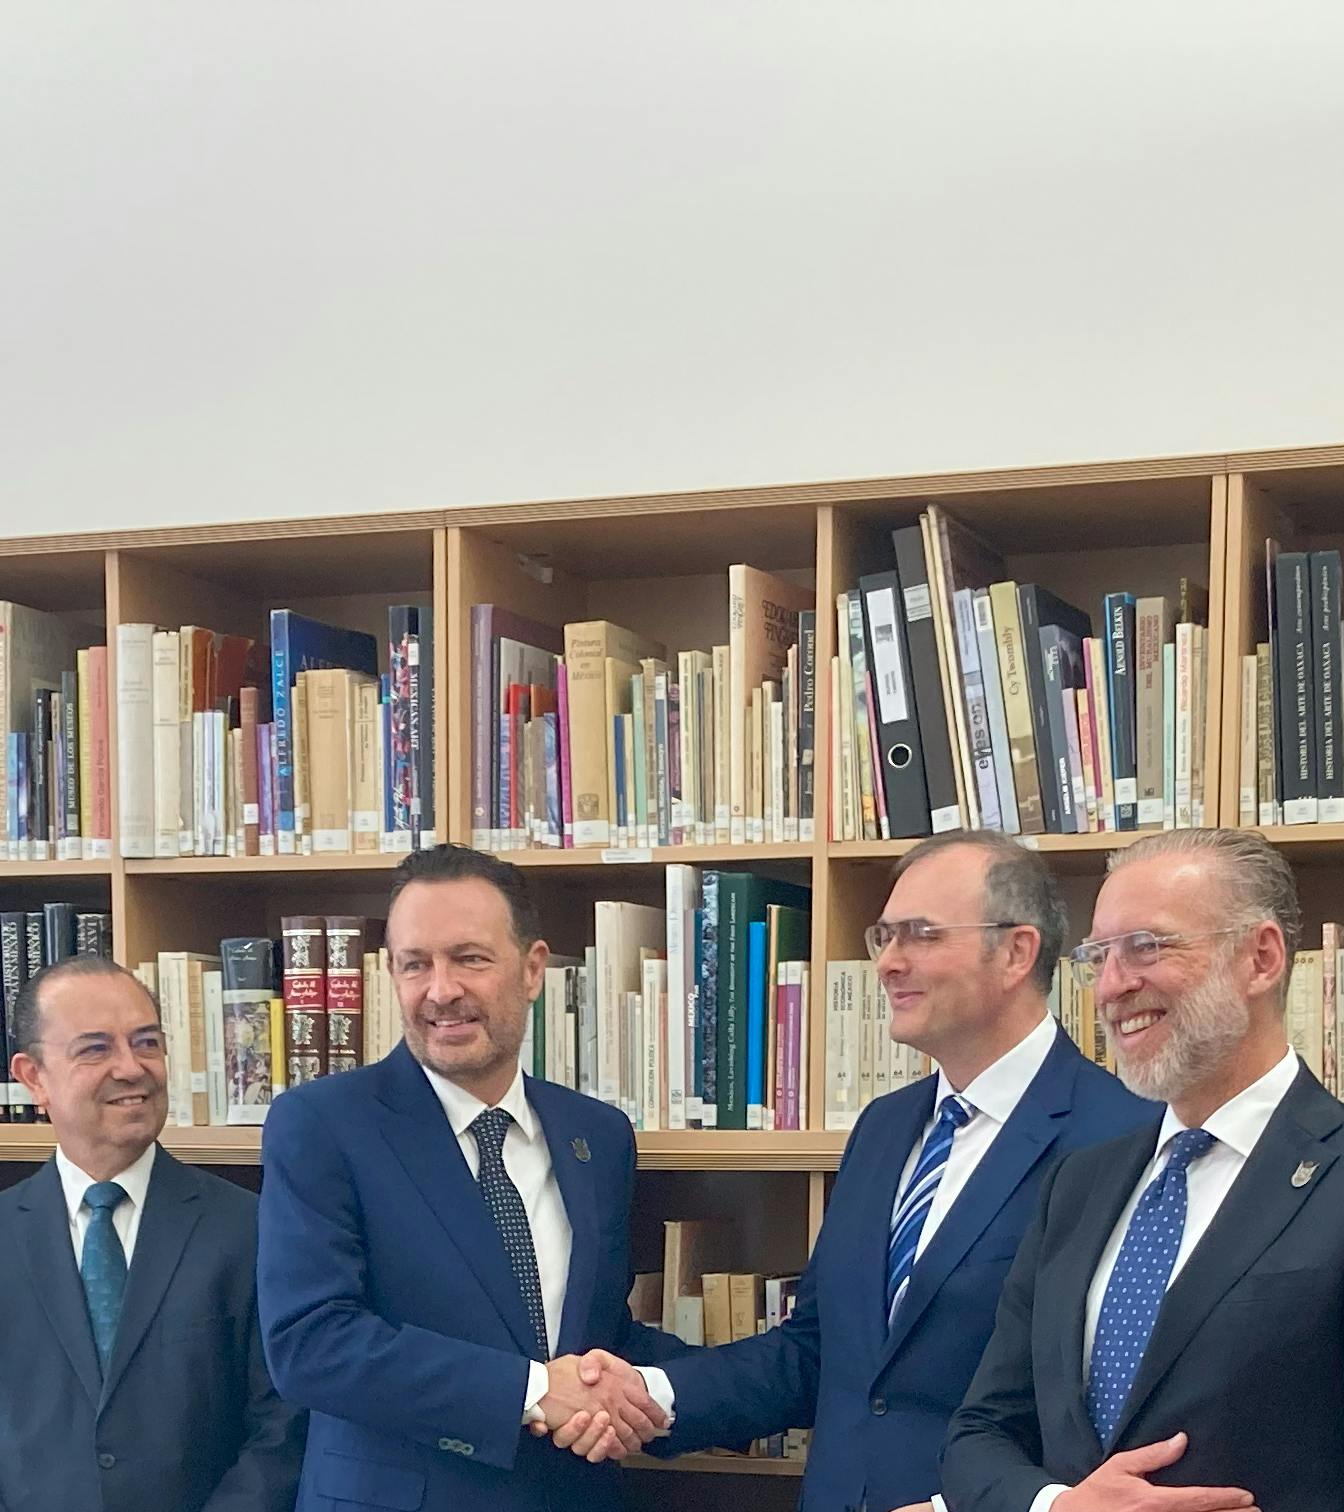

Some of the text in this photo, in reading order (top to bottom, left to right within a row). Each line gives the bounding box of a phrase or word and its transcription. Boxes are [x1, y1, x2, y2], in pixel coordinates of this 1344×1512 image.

[1002, 626, 1021, 695] Cy Twombly
[1112, 606, 1124, 639] BELKIN
[275, 650, 289, 776] ALFREDO ZALCE
[410, 673, 419, 751] MEXICAN ART
[803, 678, 814, 711] Pedro
[971, 704, 983, 725] on
[1296, 642, 1308, 780] HISTORIA DEL ARTE DE OAXACA
[1322, 642, 1334, 780] HISTORIA DEL ARTE DE OAXACA
[66, 703, 75, 808] MUSEO DE LOS MUSEOS
